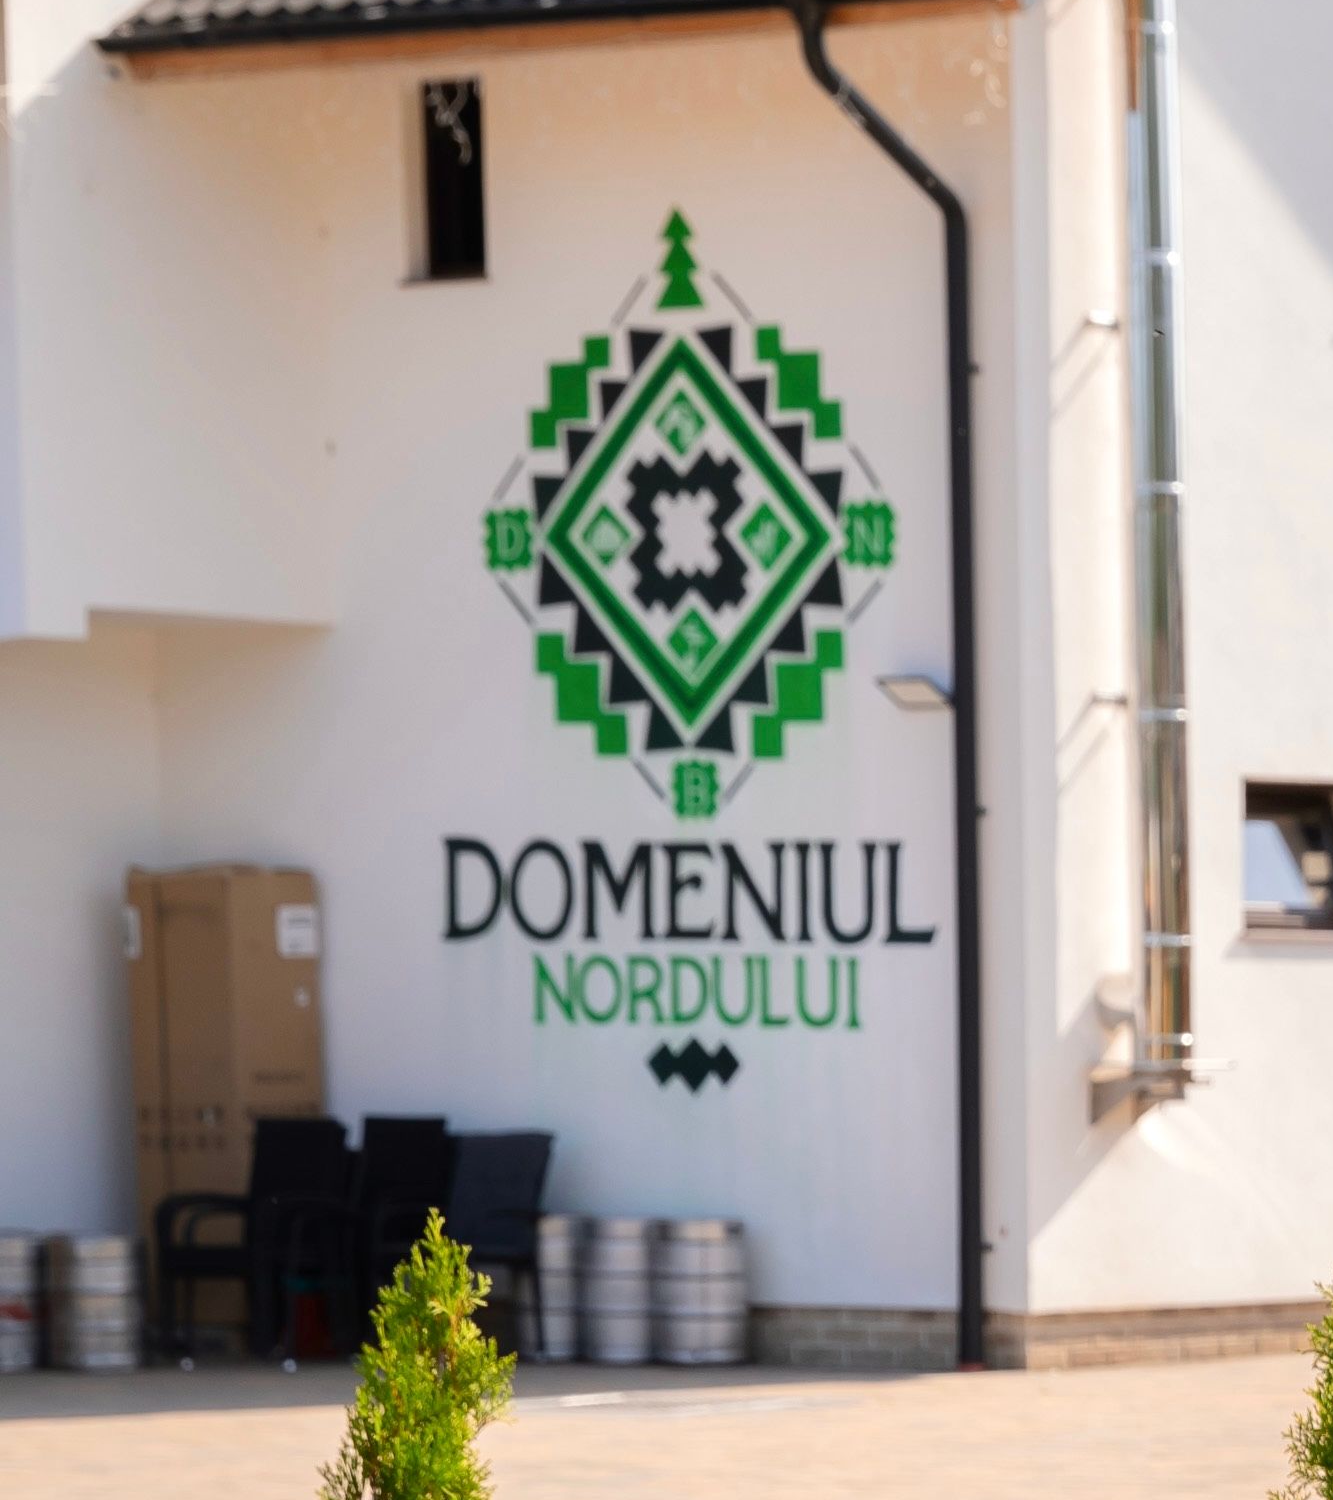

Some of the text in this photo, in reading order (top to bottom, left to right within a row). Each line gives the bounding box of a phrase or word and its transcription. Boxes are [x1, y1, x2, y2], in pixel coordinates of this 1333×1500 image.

[495, 516, 525, 560] D
[853, 514, 885, 558] N
[443, 837, 936, 944] DOMENIUL
[532, 953, 862, 1029] NORDULUI
